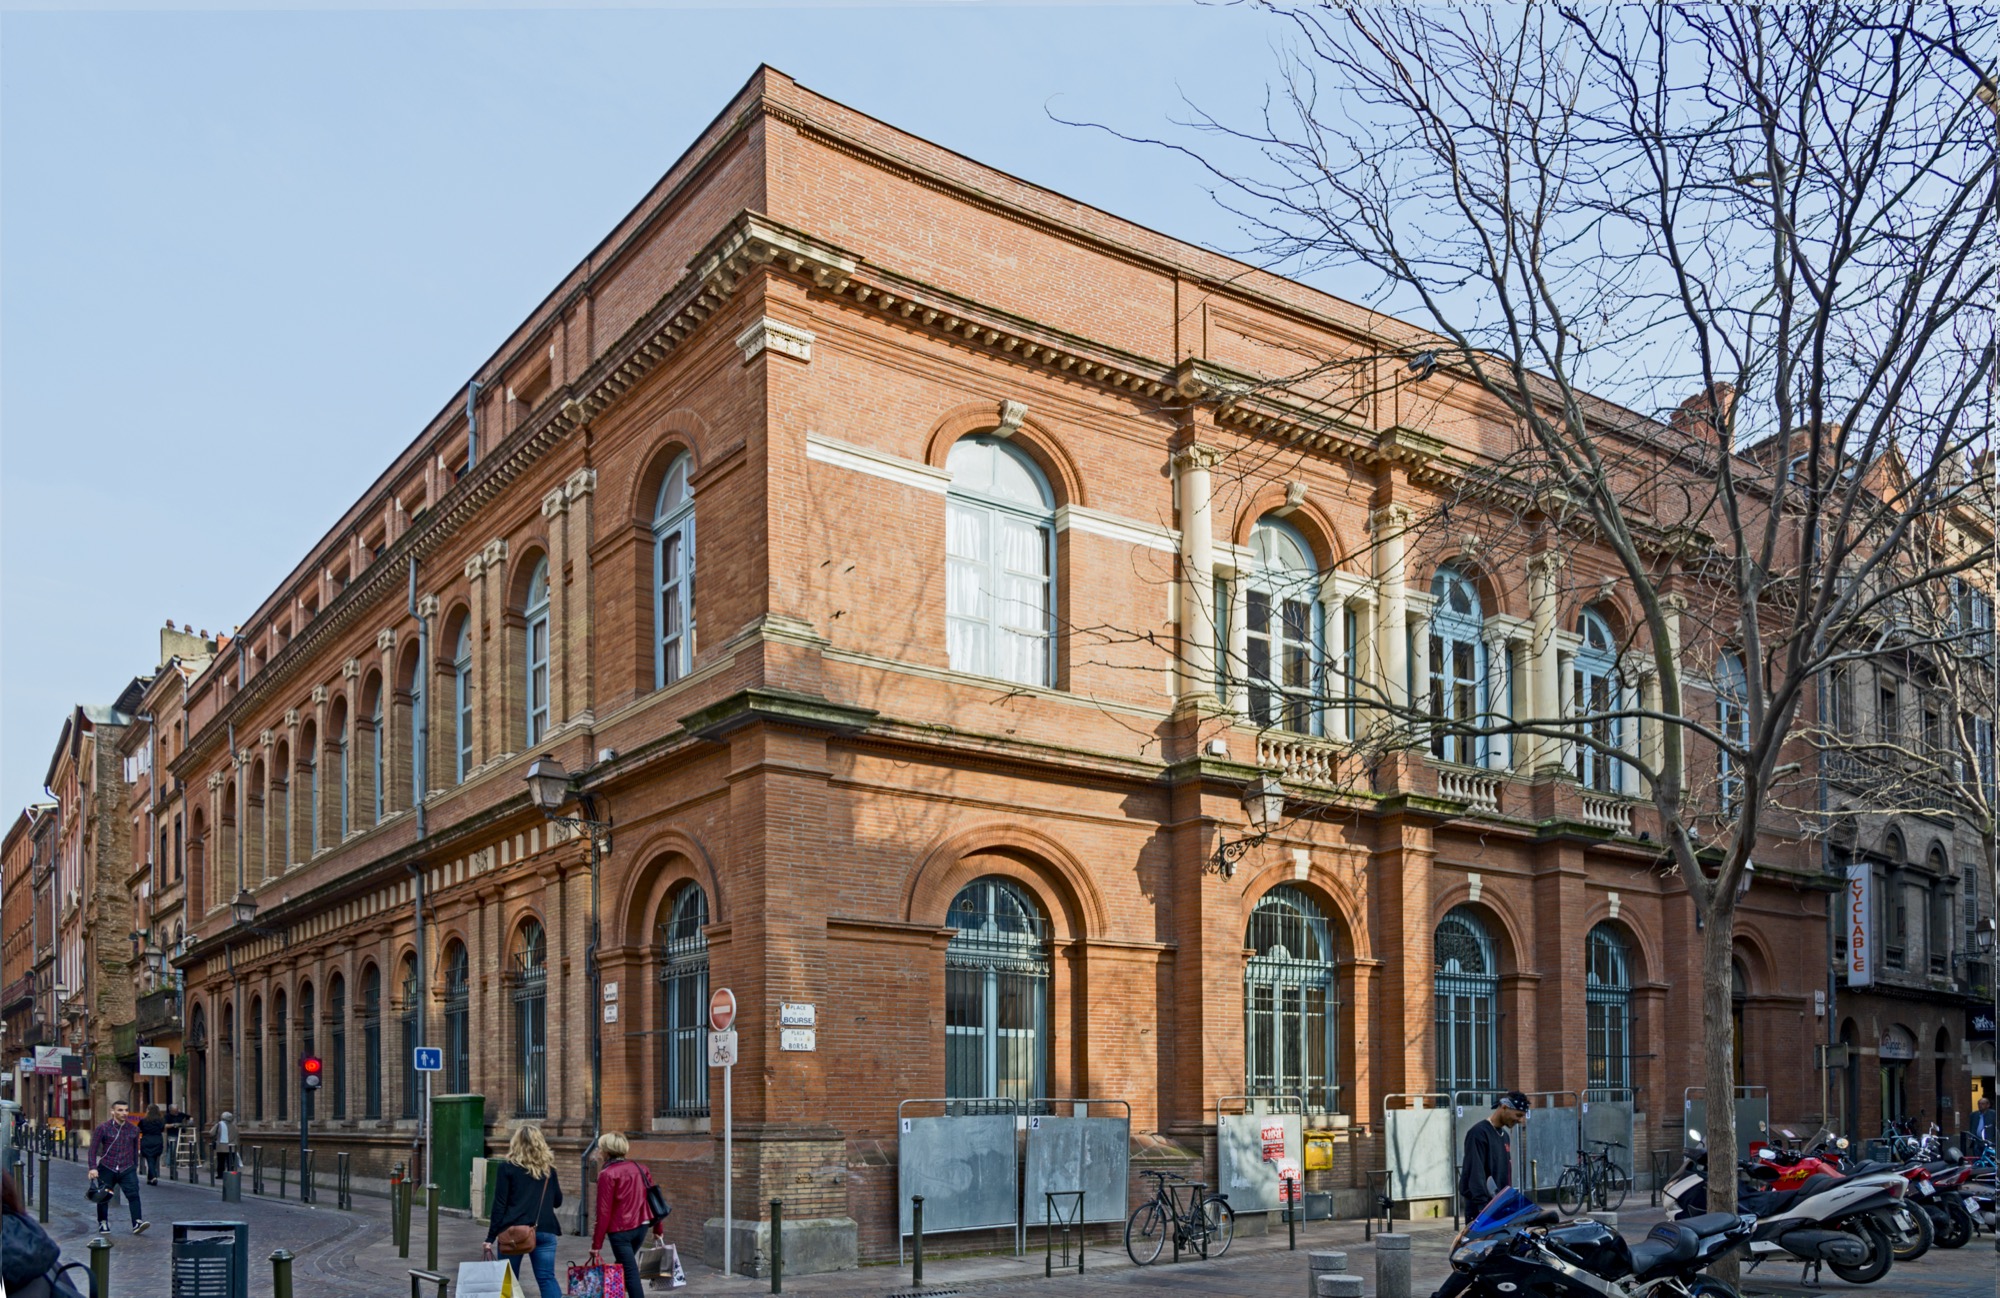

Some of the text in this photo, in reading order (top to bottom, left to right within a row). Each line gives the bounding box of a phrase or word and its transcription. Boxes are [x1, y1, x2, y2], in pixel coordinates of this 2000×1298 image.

[1852, 878, 1865, 972] CYCLABLE
[714, 1034, 729, 1043] SAUF
[142, 1060, 168, 1070] COEXIST
[904, 1120, 908, 1130] 1
[1032, 1117, 1038, 1128] 2
[1220, 1116, 1226, 1125] 3
